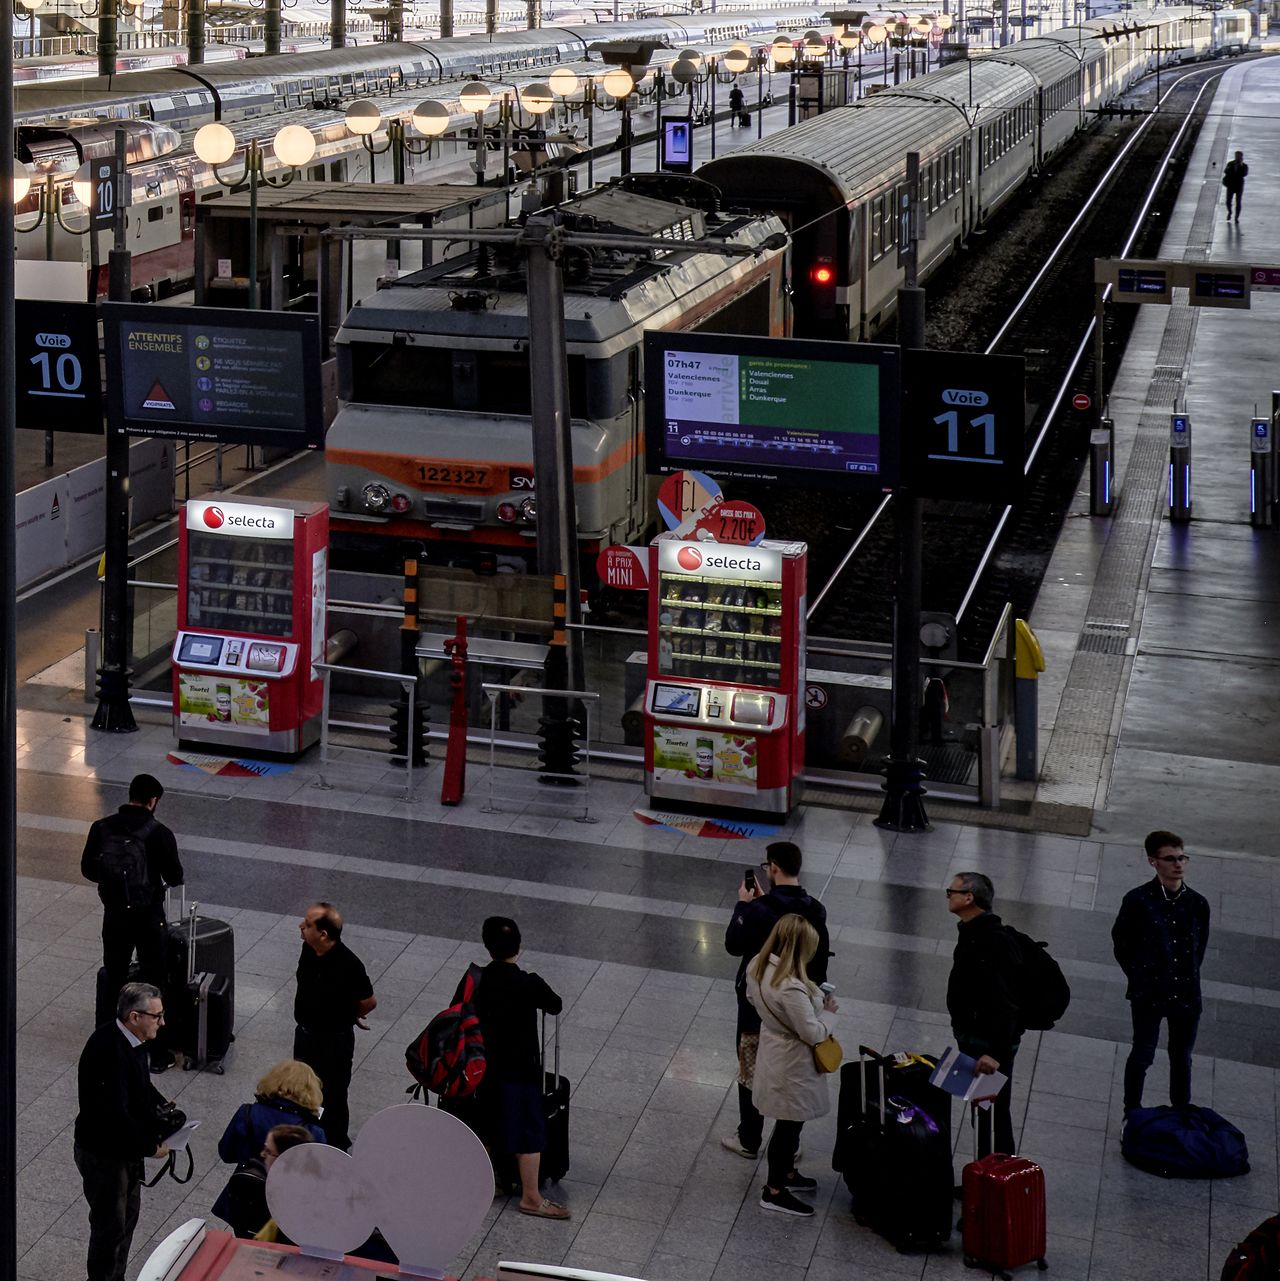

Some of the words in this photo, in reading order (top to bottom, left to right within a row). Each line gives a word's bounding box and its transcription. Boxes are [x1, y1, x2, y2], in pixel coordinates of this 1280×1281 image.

[97, 181, 112, 212] 10
[39, 335, 66, 346] Voie
[128, 332, 182, 343] ATTENTIFS
[129, 342, 182, 353] ENSEMBLE
[668, 359, 701, 369] 07h47
[30, 352, 82, 391] 10
[668, 373, 720, 382] Valenciennes
[749, 370, 794, 379] Valenciennes
[669, 388, 712, 398] Dunkerque
[749, 394, 787, 403] Dunkerque
[947, 391, 982, 404] Voie
[933, 411, 994, 455] 11
[418, 466, 487, 484] 122327
[512, 476, 535, 488] SN
[228, 515, 275, 528] selecta
[720, 518, 756, 541] 2,20€
[608, 556, 612, 566] À
[616, 557, 632, 567] PRIX
[706, 557, 760, 570] selecta
[608, 568, 632, 585] MINI
[665, 739, 689, 747] Tourtel
[716, 823, 755, 837] MINI
